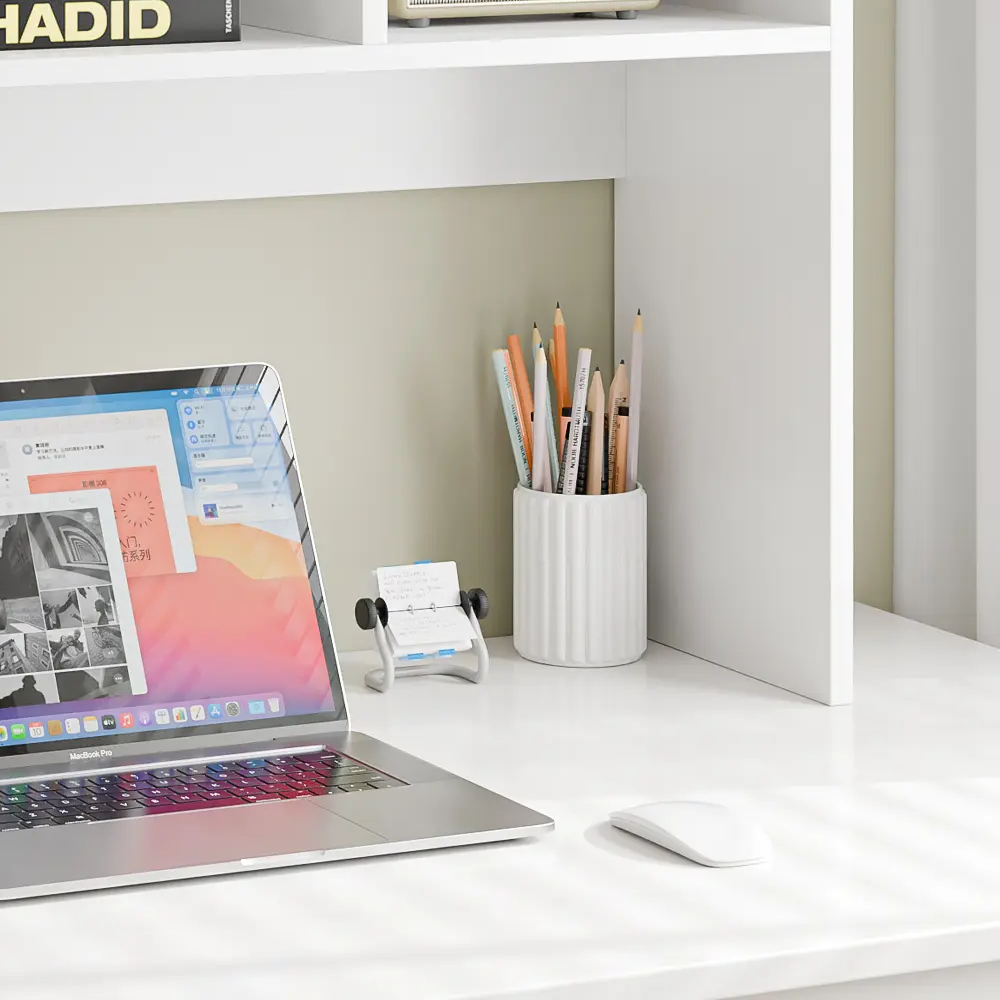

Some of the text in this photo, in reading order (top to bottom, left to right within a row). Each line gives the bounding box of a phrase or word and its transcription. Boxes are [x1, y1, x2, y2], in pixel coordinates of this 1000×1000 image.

[32, 727, 43, 737] 10
[69, 749, 113, 760] MacBook Pro
